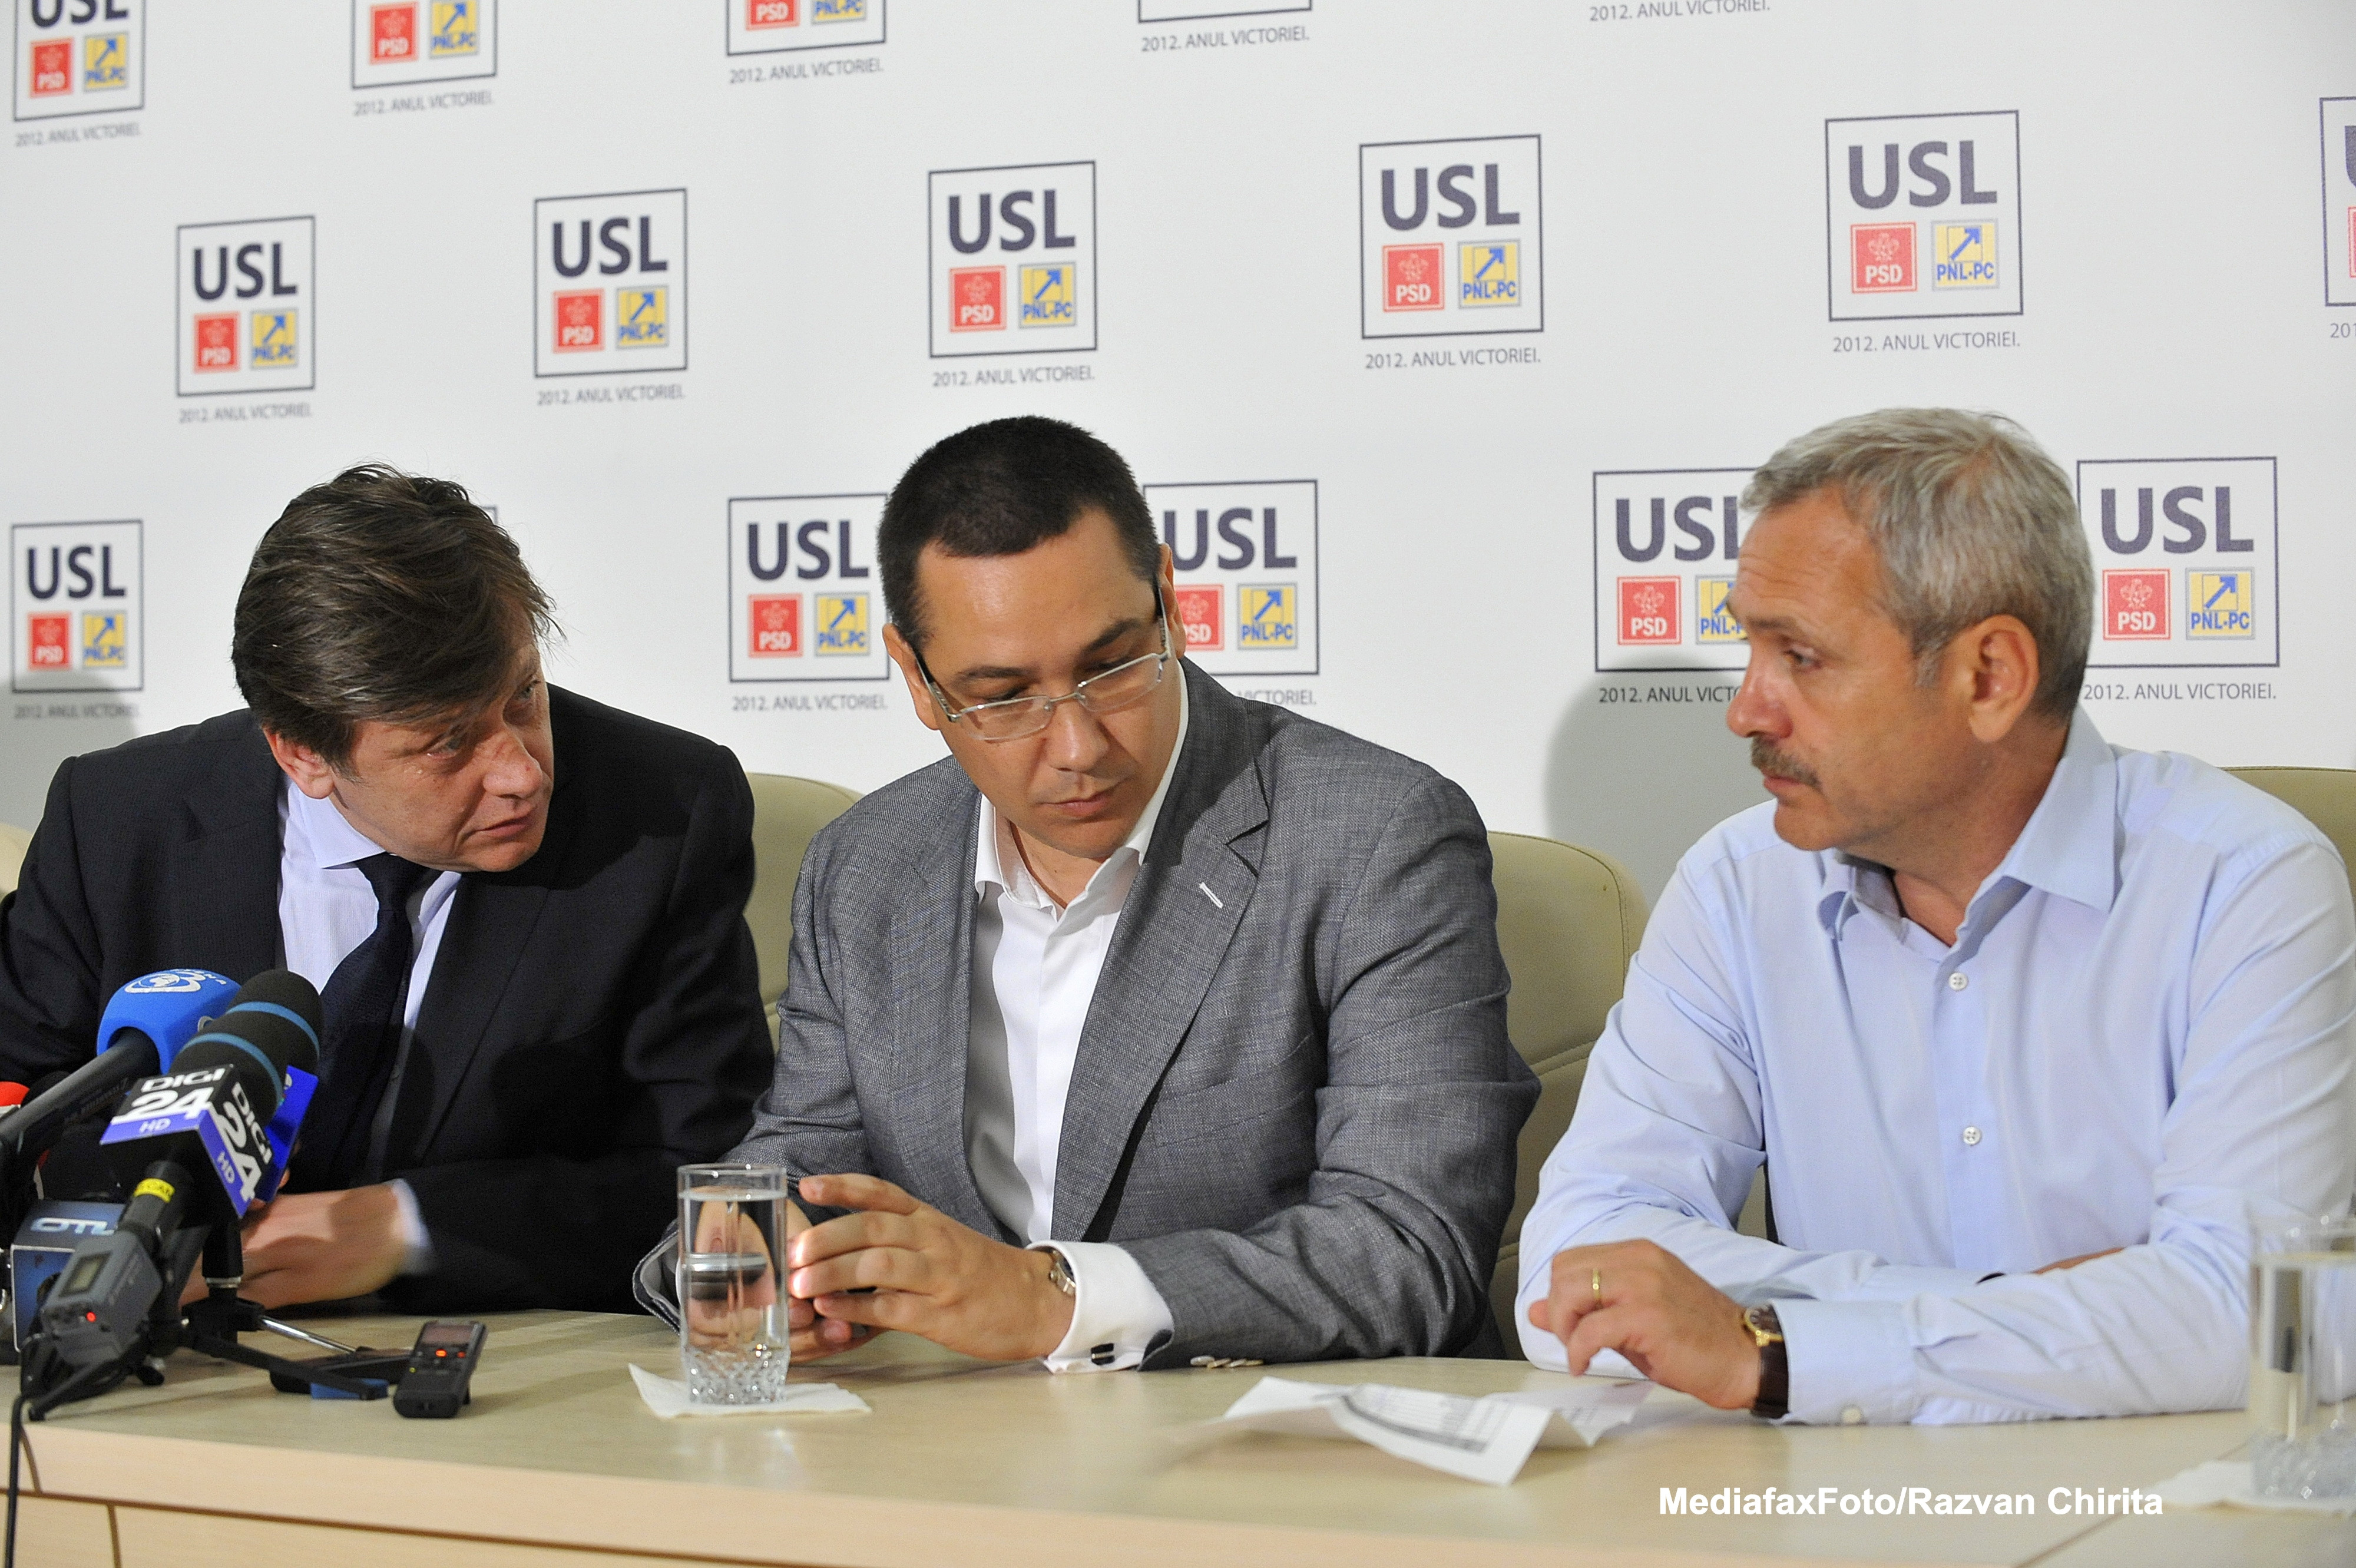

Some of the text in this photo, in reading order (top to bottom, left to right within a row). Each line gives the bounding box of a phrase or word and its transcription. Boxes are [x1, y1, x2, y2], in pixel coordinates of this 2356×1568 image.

[756, 2, 789, 22] PSD
[1637, 1, 1682, 18] ANUL
[1186, 31, 1227, 48] ANUL
[1848, 140, 1997, 209] USL
[1382, 164, 1520, 230] USL
[949, 190, 1075, 253] USL
[553, 216, 668, 277] USL
[194, 243, 297, 300] USL
[1866, 265, 1902, 284] PSD
[1396, 285, 1431, 303] PSD
[961, 305, 994, 322] PSD
[562, 325, 594, 345] PSD
[1833, 331, 2020, 352] 2012. ANUL VICTORIEI.
[1366, 348, 1541, 369] 2012. ANUL VICTORIEI.
[974, 369, 1015, 384] ANUL
[2101, 486, 2254, 554] USL
[1164, 507, 1297, 571] USL
[748, 520, 869, 581] USL
[27, 544, 126, 599] USL
[1631, 617, 1667, 636] PSD
[2118, 611, 2156, 631] PSD
[759, 631, 791, 650] PSD
[1600, 687, 1642, 703] 2012.
[1647, 686, 1692, 702] ANUL
[2084, 683, 2276, 700] 2012. ANUL VICTORIEI.
[141, 1068, 226, 1093] DIGI
[111, 1087, 214, 1126] 24
[139, 1118, 171, 1133] HD
[232, 1082, 273, 1165] DIGI
[207, 1101, 262, 1202] 24
[217, 1152, 235, 1184] HD
